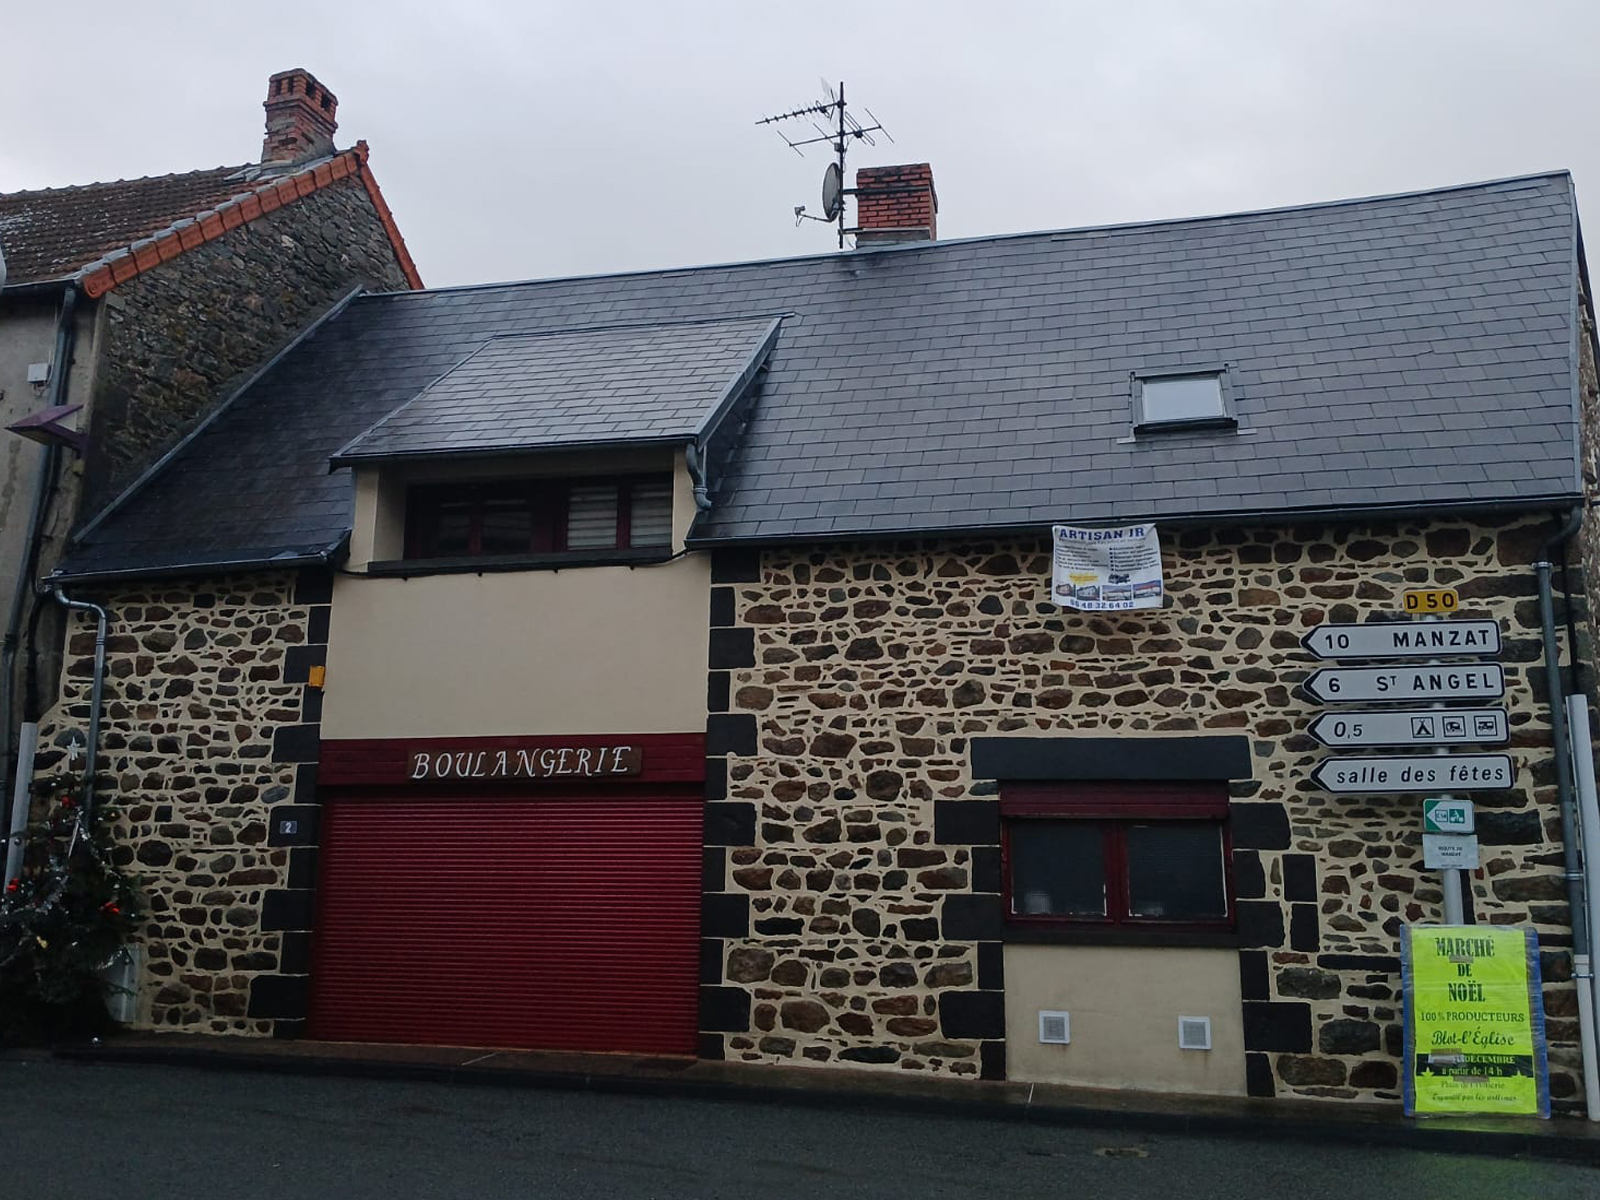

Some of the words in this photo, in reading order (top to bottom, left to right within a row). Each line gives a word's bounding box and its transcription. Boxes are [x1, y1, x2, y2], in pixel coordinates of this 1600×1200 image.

[1060, 528, 1123, 541] ARTISAN
[1407, 594, 1418, 609] D
[1427, 593, 1454, 607] 50
[1326, 634, 1349, 649] 10
[1393, 630, 1489, 647] MANZAT
[1329, 678, 1341, 692] 6
[1413, 674, 1494, 690] ANGEL
[1334, 722, 1363, 739] 0,5
[412, 746, 631, 779] BOULANGERIE
[1337, 767, 1388, 784] salle
[1401, 766, 1436, 782] des
[1450, 765, 1503, 781] fêtes
[285, 821, 292, 833] 2
[1435, 935, 1495, 957] MARCHÉ
[1457, 963, 1472, 977] DE
[1448, 980, 1486, 1002] NOËL
[1446, 1011, 1525, 1023] PRODUCTEURS
[1471, 1066, 1481, 1075] de
[1484, 1066, 1494, 1075] 14
[1497, 1066, 1503, 1075] h
